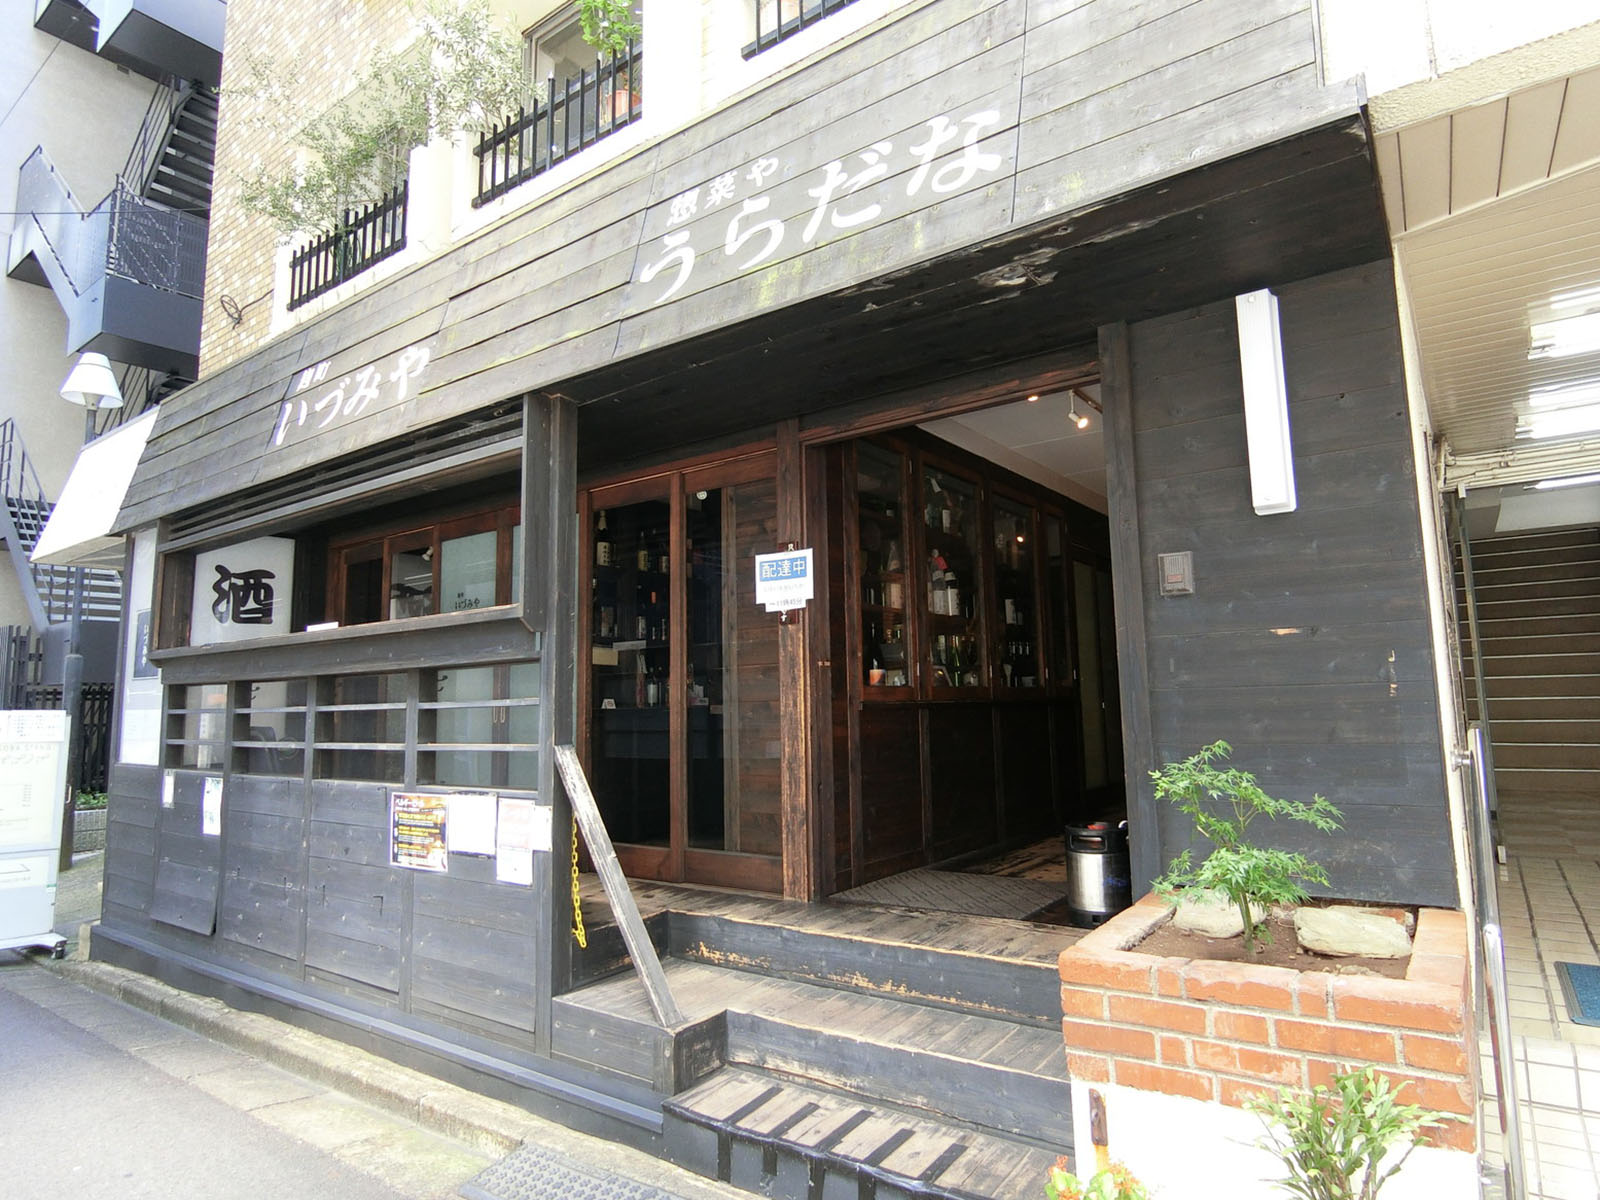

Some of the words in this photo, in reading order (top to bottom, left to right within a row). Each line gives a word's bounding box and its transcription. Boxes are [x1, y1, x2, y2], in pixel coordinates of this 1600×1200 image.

[639, 110, 1002, 304] うらだな
[274, 346, 431, 446] いづみや
[211, 564, 276, 625] 酒
[761, 558, 806, 579] 配達中
